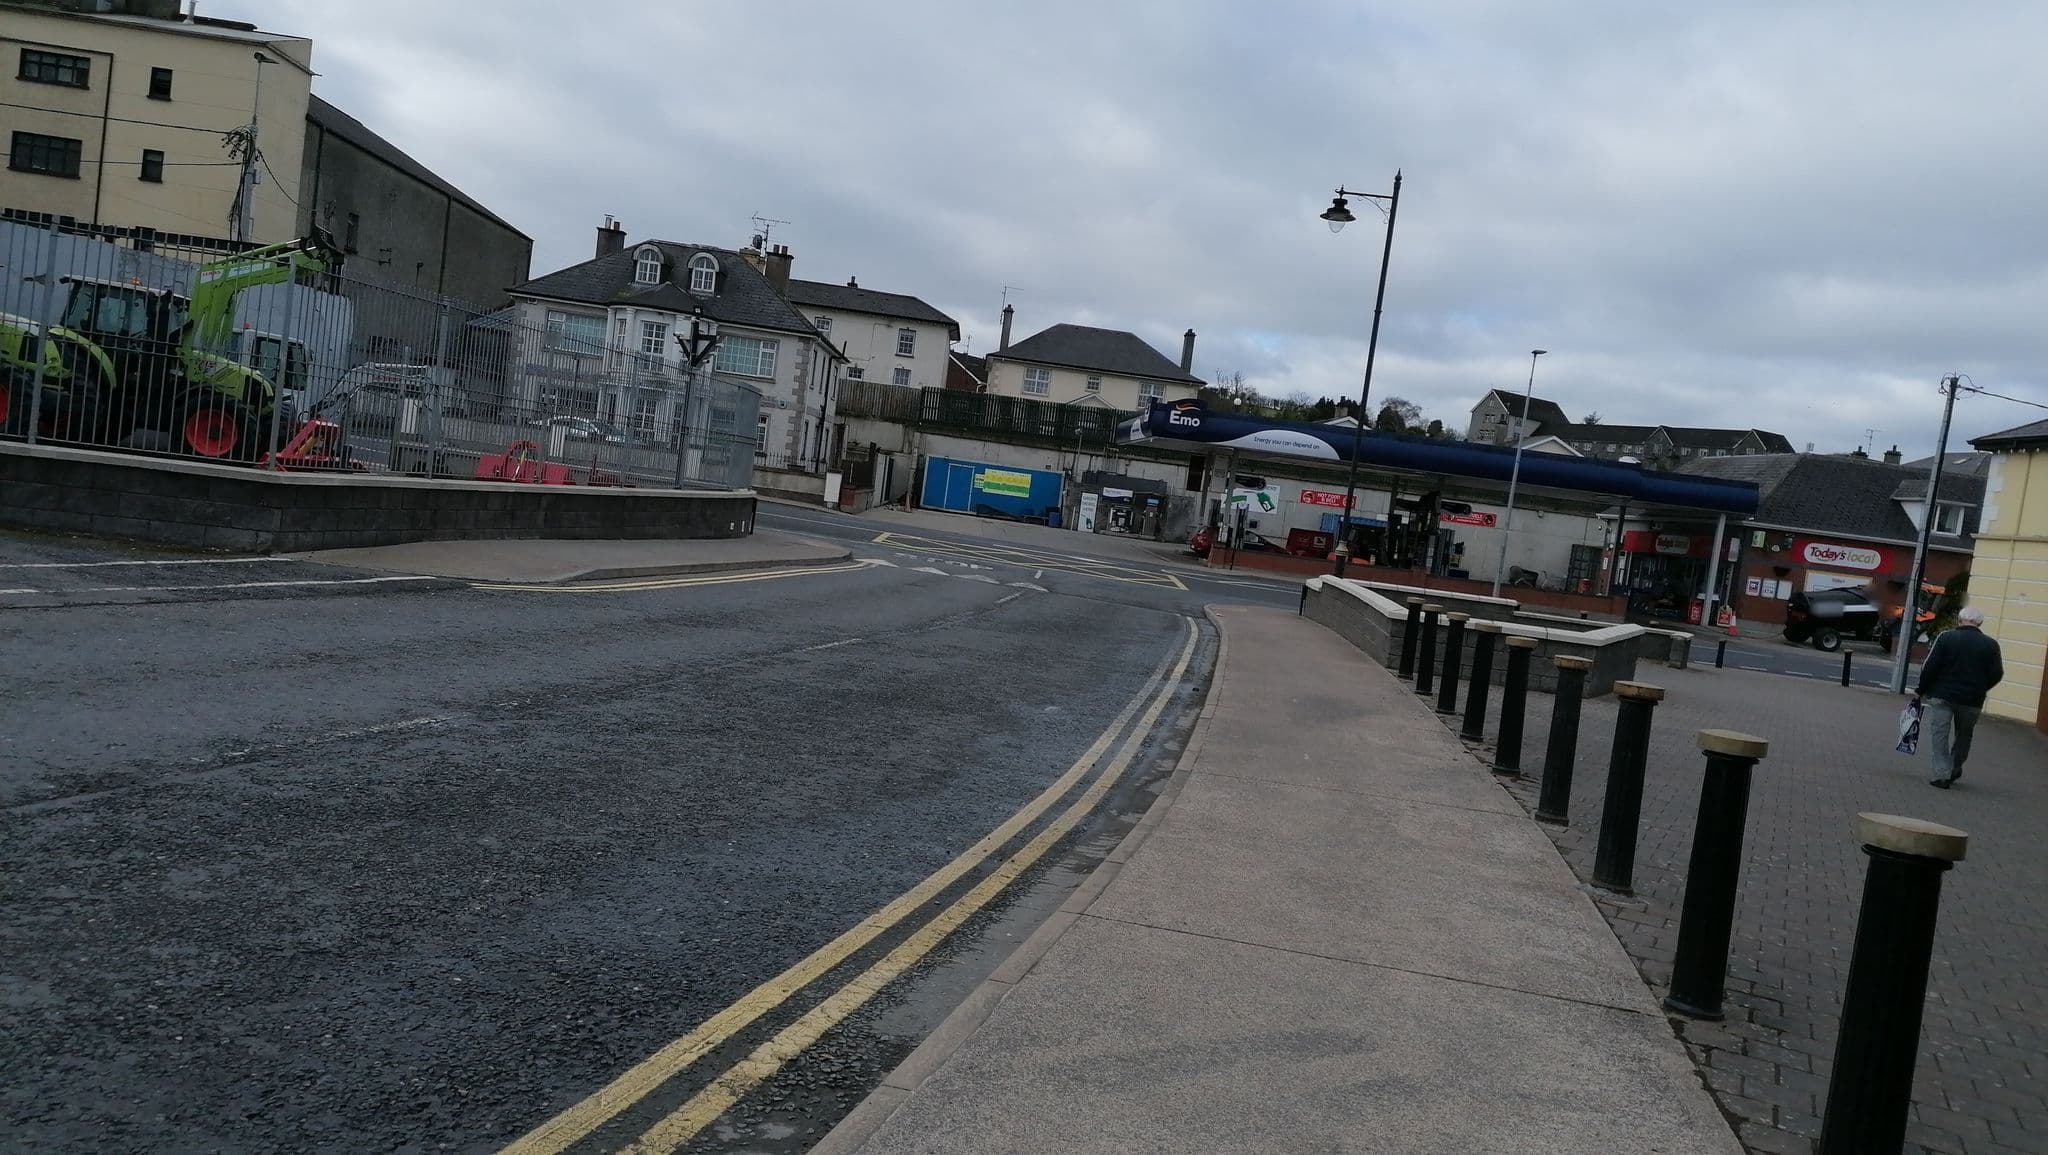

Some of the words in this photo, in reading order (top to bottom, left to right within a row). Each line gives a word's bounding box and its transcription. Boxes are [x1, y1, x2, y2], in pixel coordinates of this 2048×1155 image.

[1169, 410, 1200, 427] Emo
[1254, 436, 1271, 444] Energy
[1292, 441, 1312, 449] depend
[1810, 546, 1847, 561] Today's
[1847, 551, 1875, 564] local
